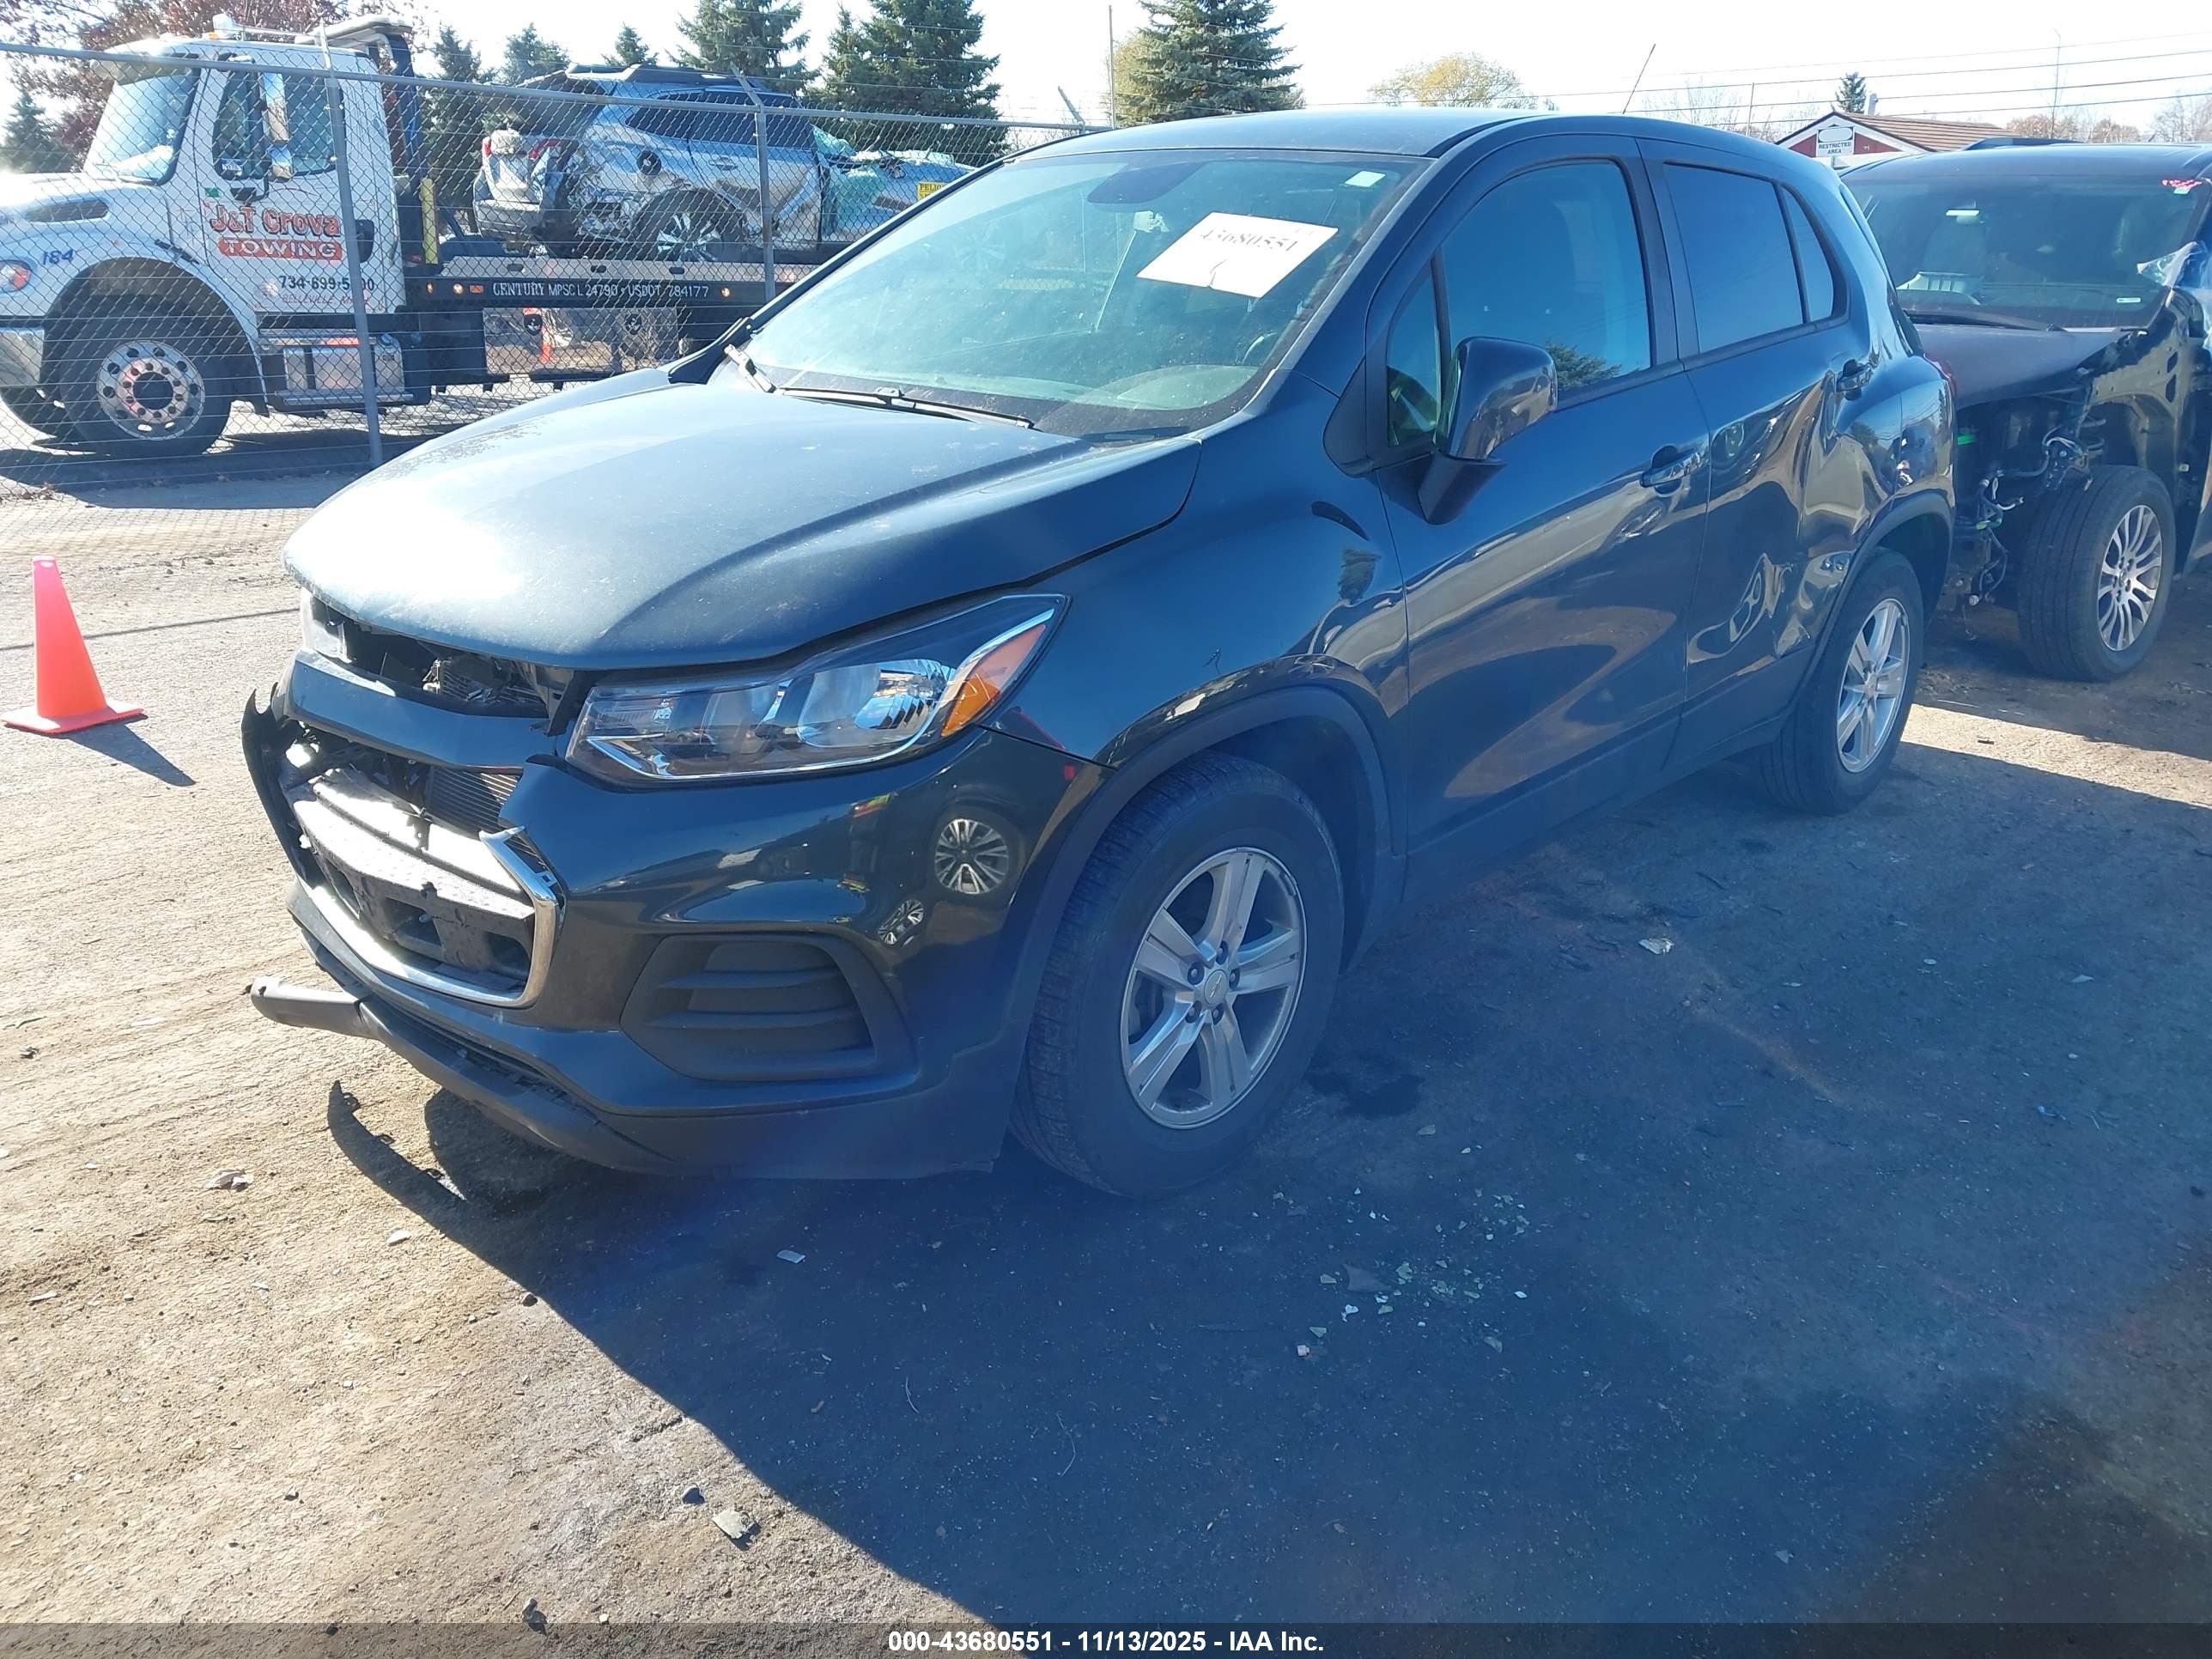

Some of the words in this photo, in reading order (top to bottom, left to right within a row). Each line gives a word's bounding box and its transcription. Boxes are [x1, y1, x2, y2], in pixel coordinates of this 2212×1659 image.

[210, 205, 256, 233] J&T
[262, 208, 341, 237] Crova
[42, 247, 74, 264] 184
[223, 240, 336, 258] TOWING
[492, 282, 544, 296] CENTURY
[548, 283, 575, 296] MPSC
[628, 283, 660, 297] USDOT
